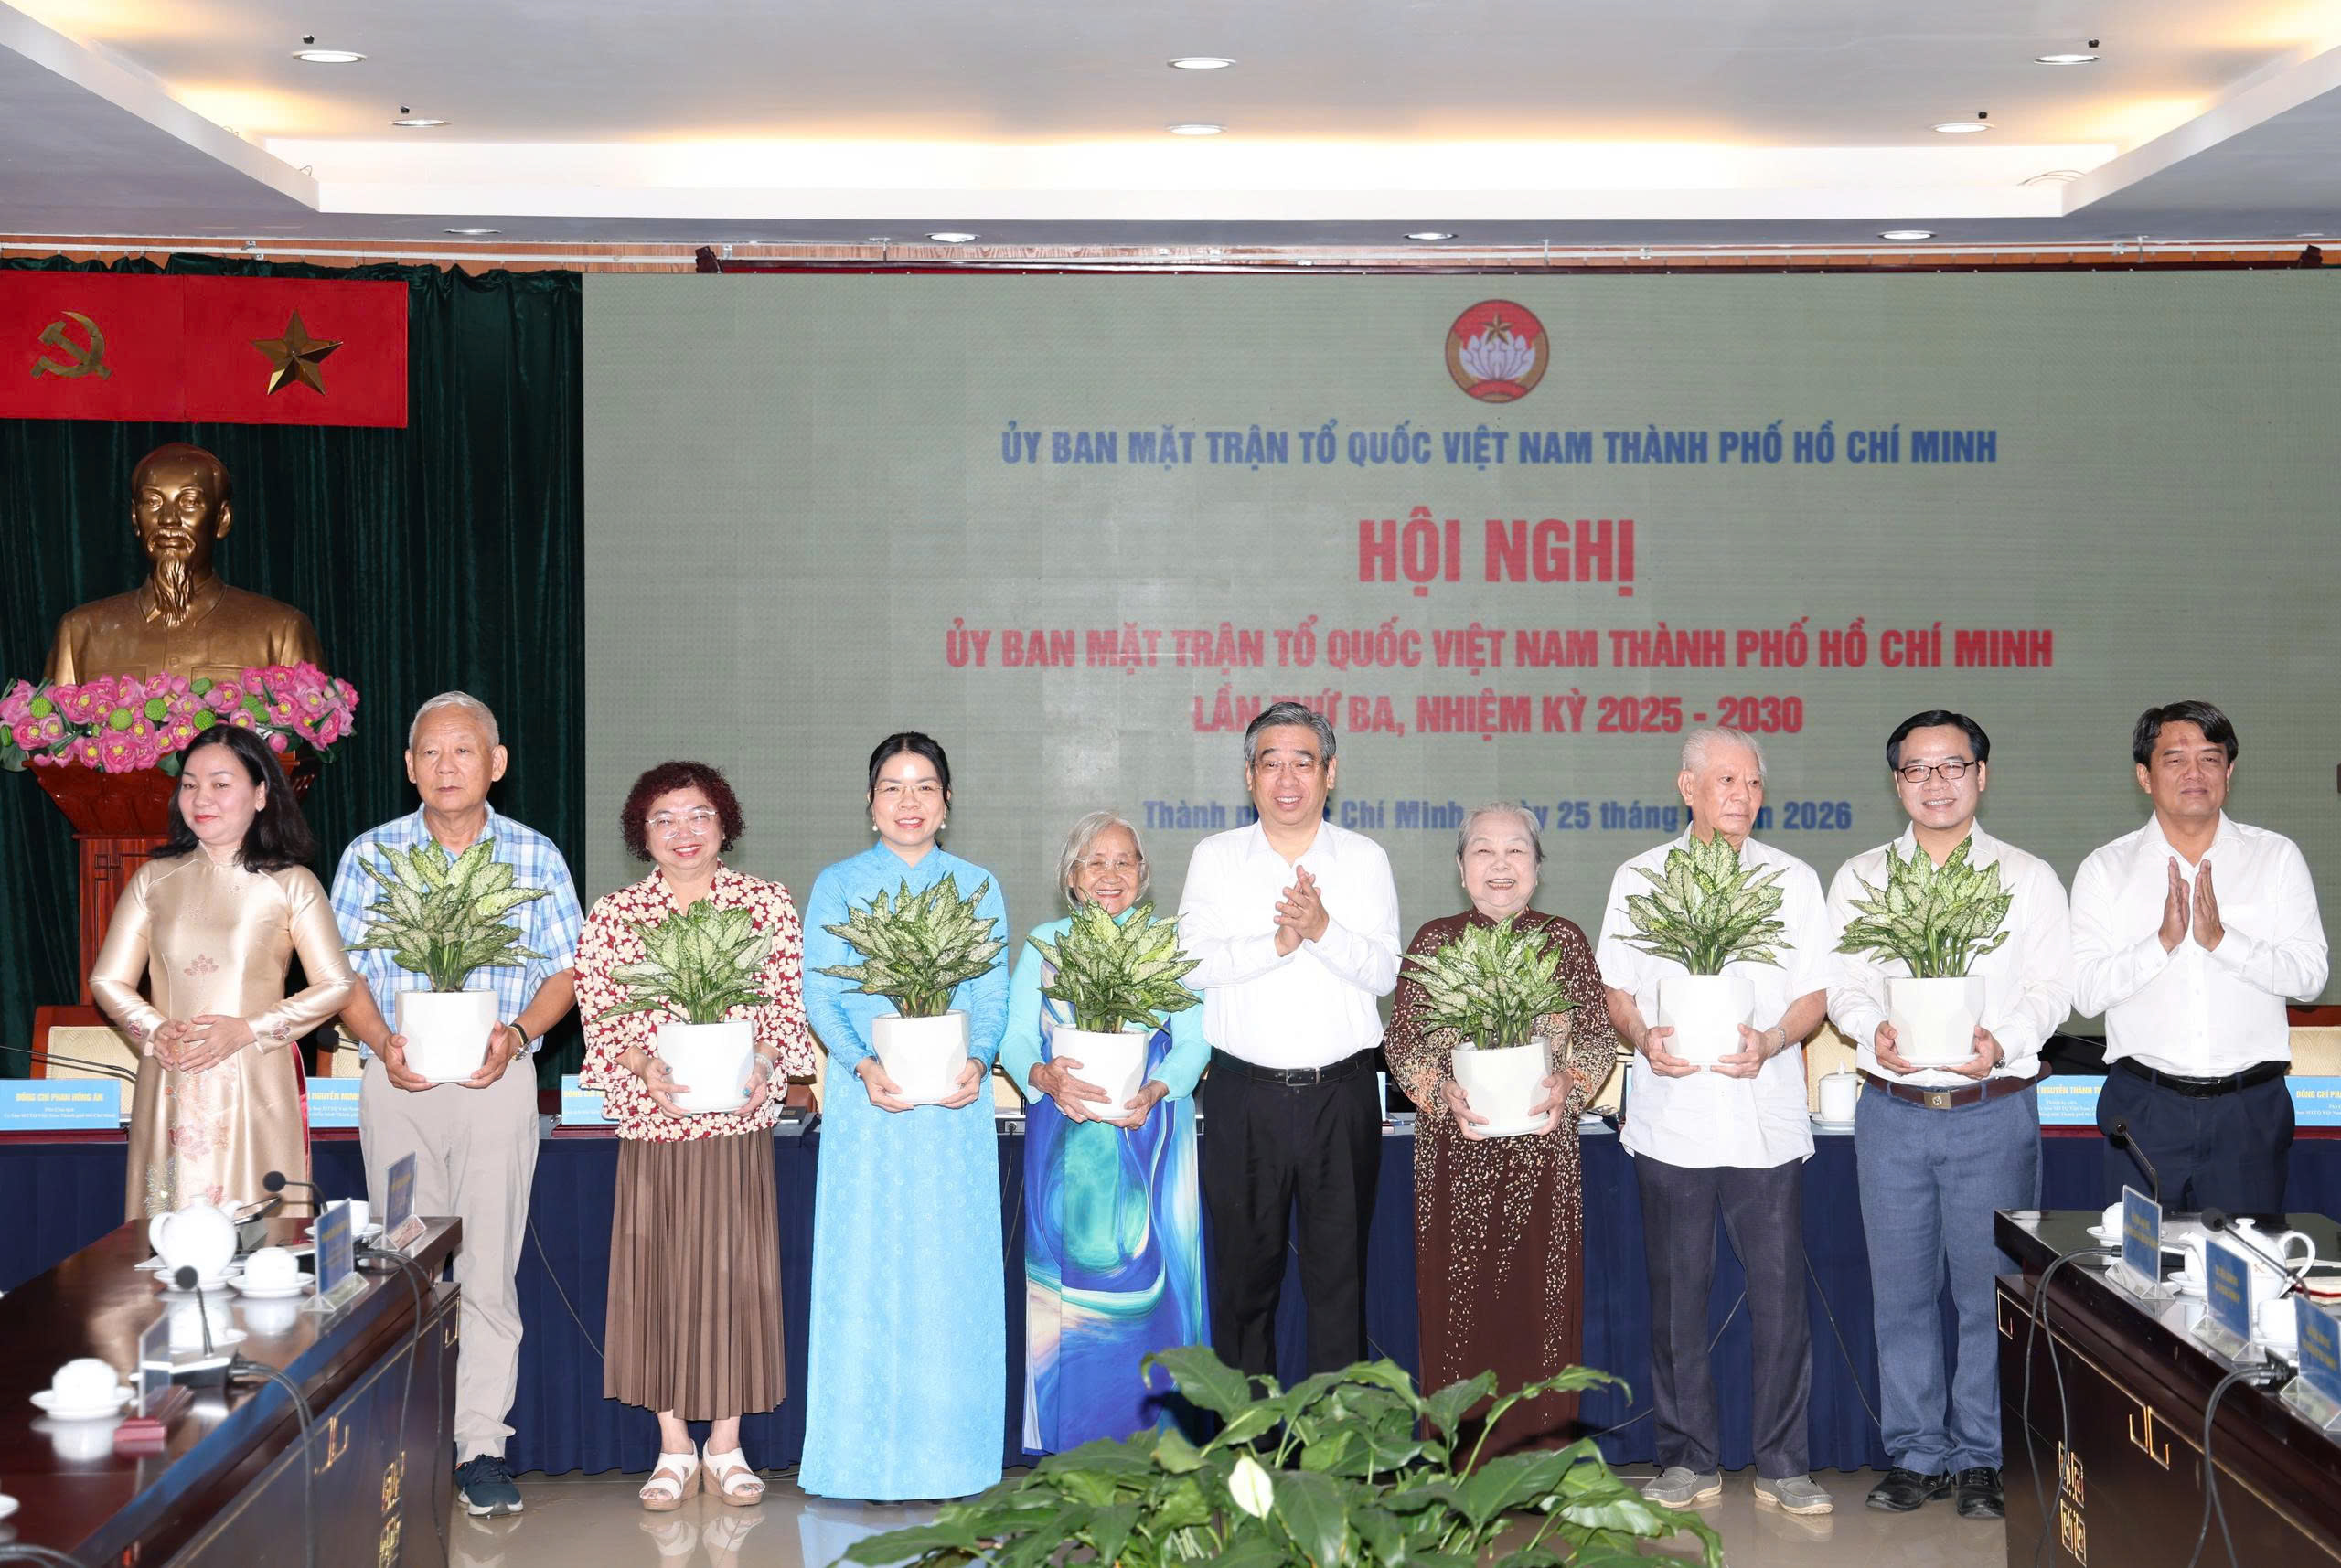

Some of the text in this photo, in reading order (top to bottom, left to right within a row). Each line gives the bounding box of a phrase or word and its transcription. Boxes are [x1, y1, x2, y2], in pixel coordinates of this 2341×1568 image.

[1001, 418, 1996, 472] ỦY BAN MẶT TRẬN TỔ QUỐC VIỆT NAM THÀNH PHỐ HỒ CHÍ MINH
[1359, 507, 1634, 597] HỘI NGHỊ
[946, 615, 2053, 676] ỦY BAN MẶT TRẬN TỔ QUỐC VIỆT NAM THÀNH PHỐ HỒ CHÍ MINH
[1349, 696, 1405, 737] BA,
[1416, 688, 1531, 741] NHIỆM
[1543, 688, 1587, 732] KỲ
[1597, 695, 1683, 733] 2025
[1717, 695, 1804, 733] 2030
[1144, 799, 1226, 830] Thành
[1341, 799, 1384, 830] Chí
[1558, 799, 1591, 830] 25
[1600, 801, 1678, 834] tháng
[1783, 800, 1853, 831] 2026
